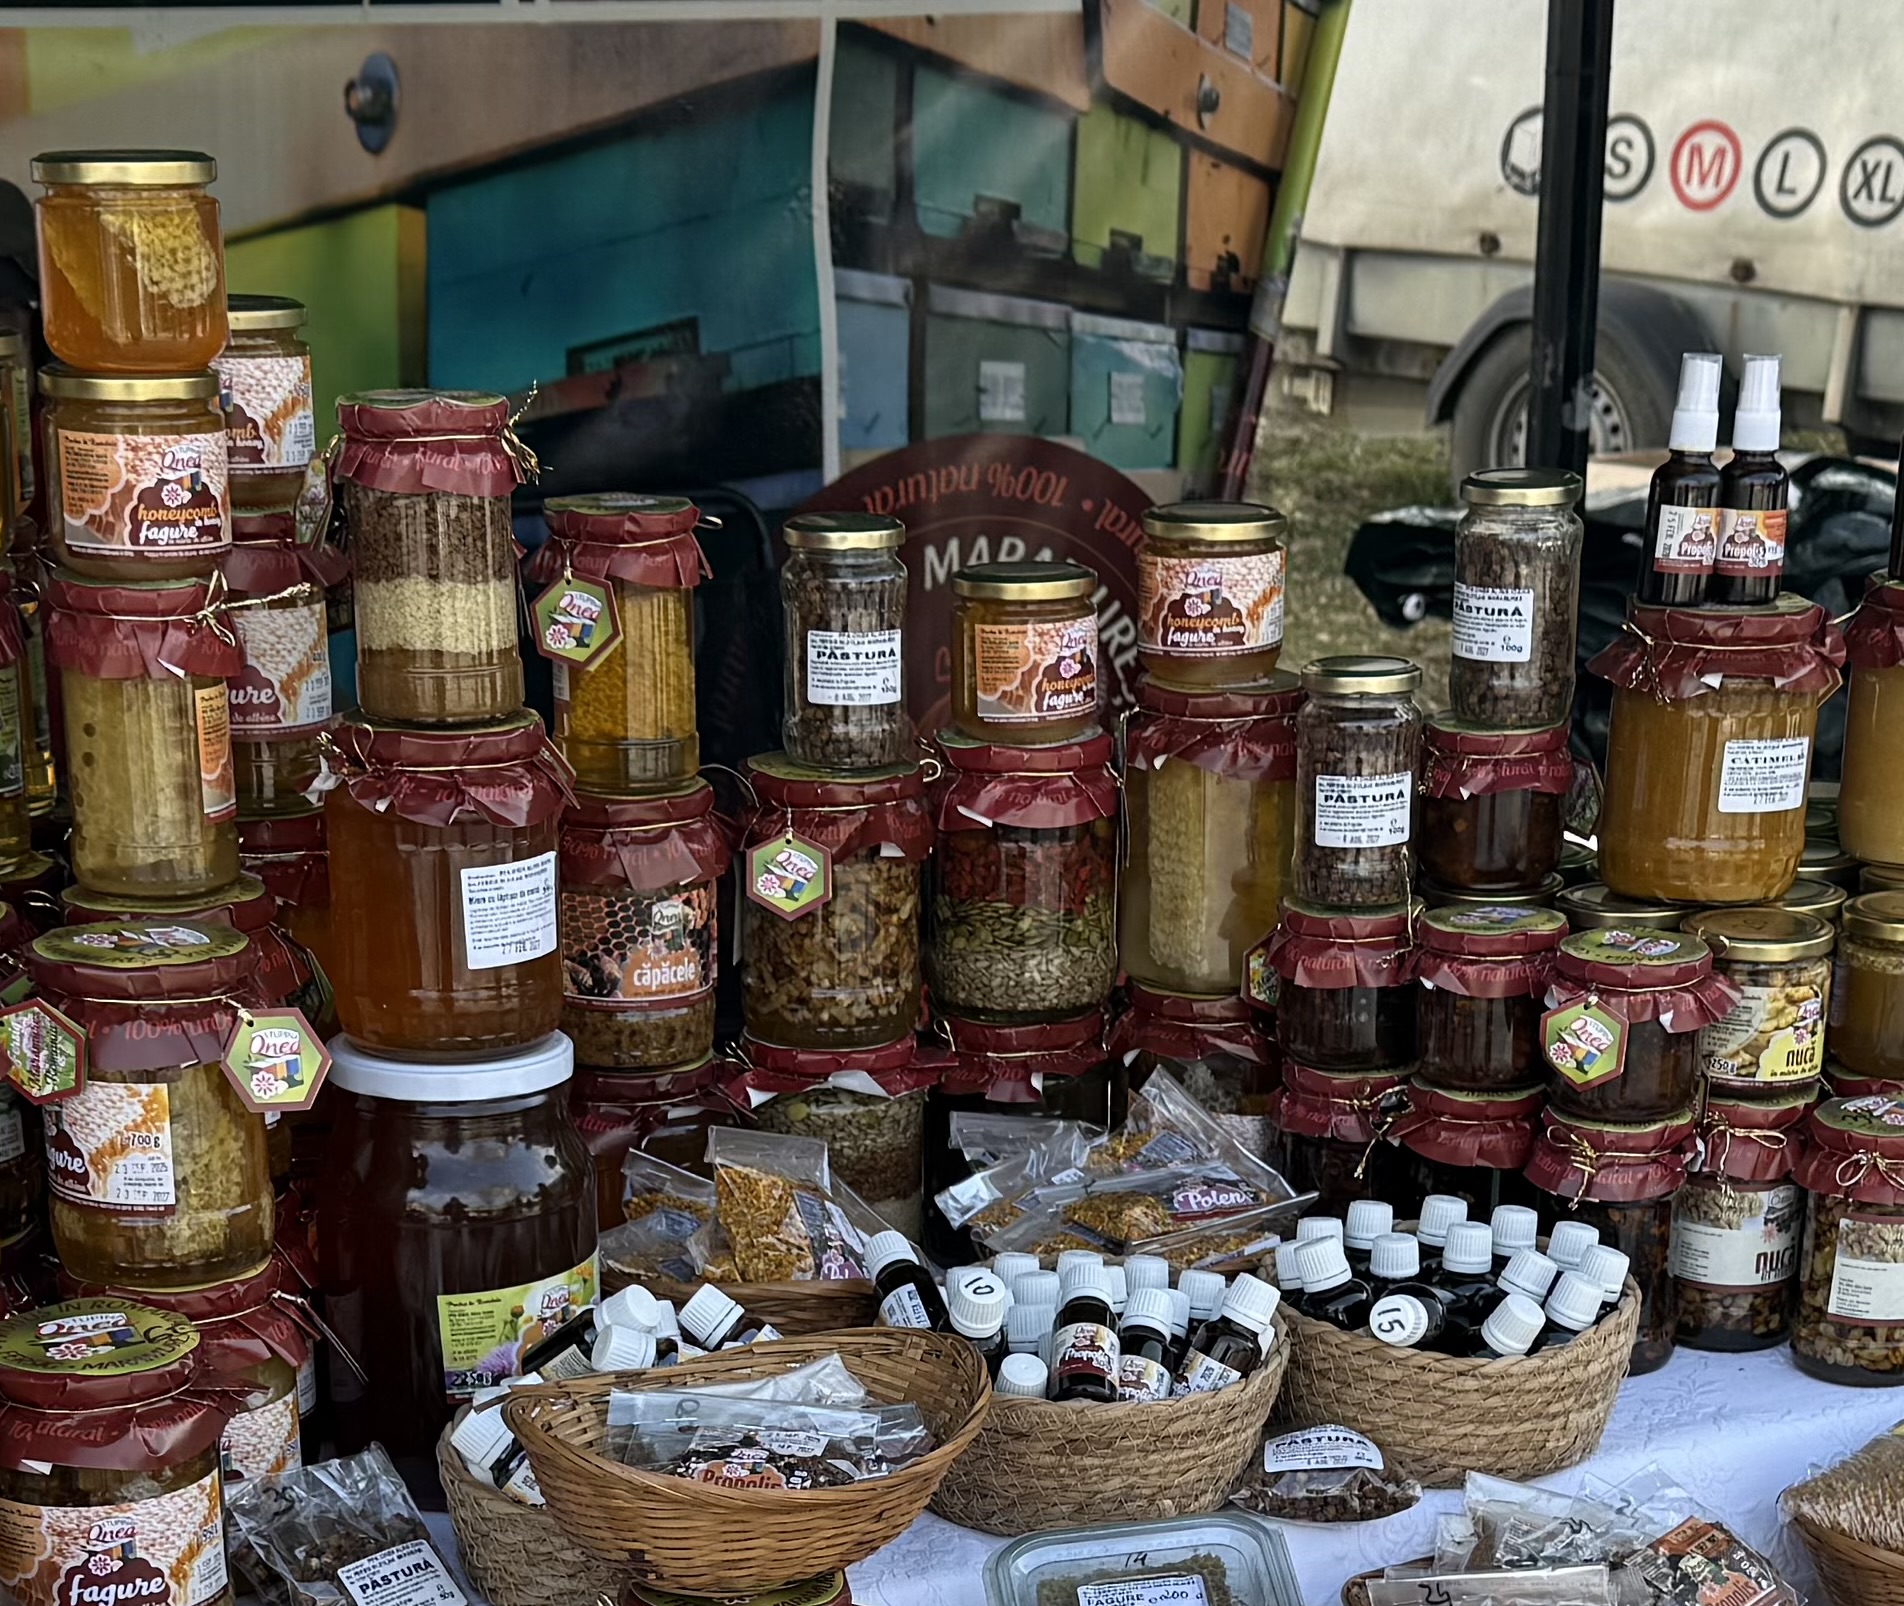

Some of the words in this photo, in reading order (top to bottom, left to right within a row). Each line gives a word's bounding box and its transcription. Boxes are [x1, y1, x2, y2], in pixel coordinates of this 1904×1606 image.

[1608, 137, 1633, 178] S
[1684, 144, 1727, 188] M
[1777, 151, 1797, 194] L
[1852, 159, 1899, 203] XL
[138, 505, 218, 523] honeycomb
[139, 521, 198, 545] fagure
[1167, 613, 1241, 630] honeycomb
[1167, 627, 1215, 647] fagure
[1179, 1190, 1246, 1210] Polen
